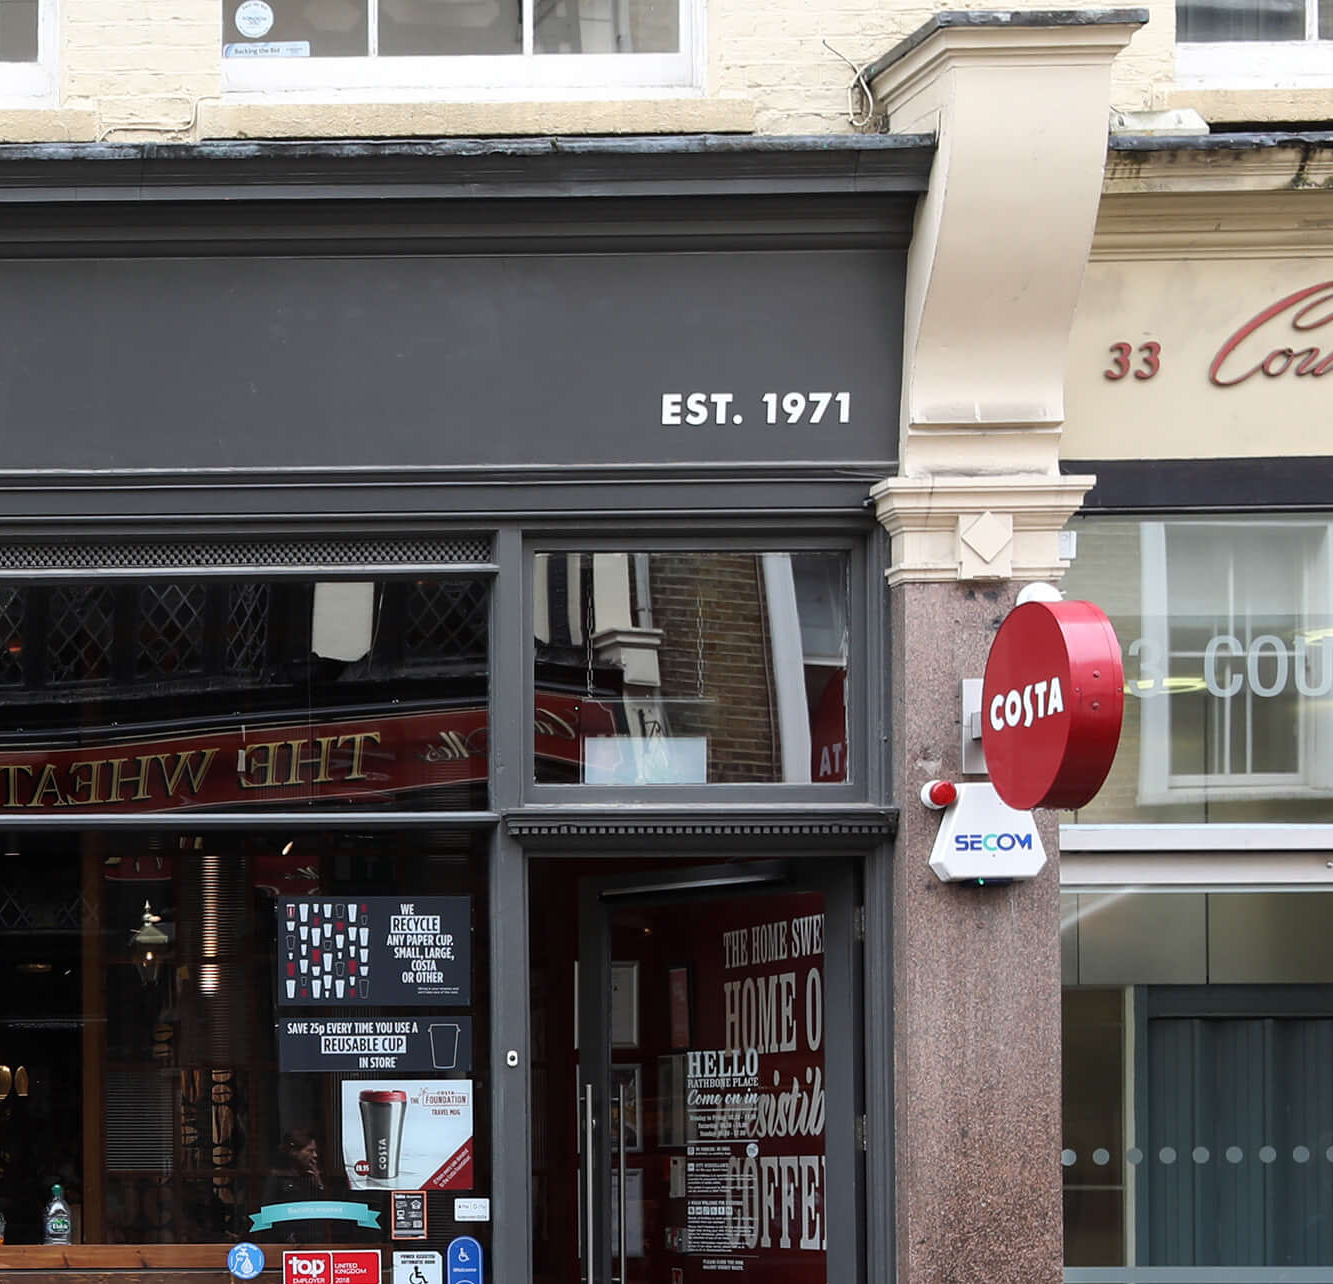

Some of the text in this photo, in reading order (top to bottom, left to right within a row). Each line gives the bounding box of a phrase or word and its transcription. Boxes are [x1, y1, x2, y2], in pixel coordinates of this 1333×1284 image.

[1104, 281, 1333, 387] 33 Cou
[661, 392, 852, 425] EST. 1971
[1126, 638, 1164, 697] 3
[989, 676, 1065, 731] COSTA
[954, 833, 1033, 852] SECOM
[400, 904, 414, 915] WE
[393, 917, 438, 932] RECYCLE
[386, 934, 454, 946] ANY PAPER CUP.
[723, 913, 825, 969] THE HOME SWE
[394, 947, 455, 961] SMALL, LARGE,
[411, 960, 437, 971] COSTA
[402, 972, 443, 983] OR OTHER
[724, 967, 822, 1057] HOME O
[287, 1022, 418, 1036] SAVE 25p EVERY TIME YOU USE A
[324, 1037, 404, 1052] REUSABLE CUP
[359, 1057, 368, 1068] IN
[687, 1048, 758, 1078] HELLO
[687, 1077, 759, 1088] RATHBONE PLACE
[425, 1096, 466, 1104] FOUNDATION
[687, 1088, 758, 1105] Come on in
[378, 1138, 387, 1170] COSTA
[726, 1155, 827, 1251] COFFE
[288, 1256, 326, 1278] top
